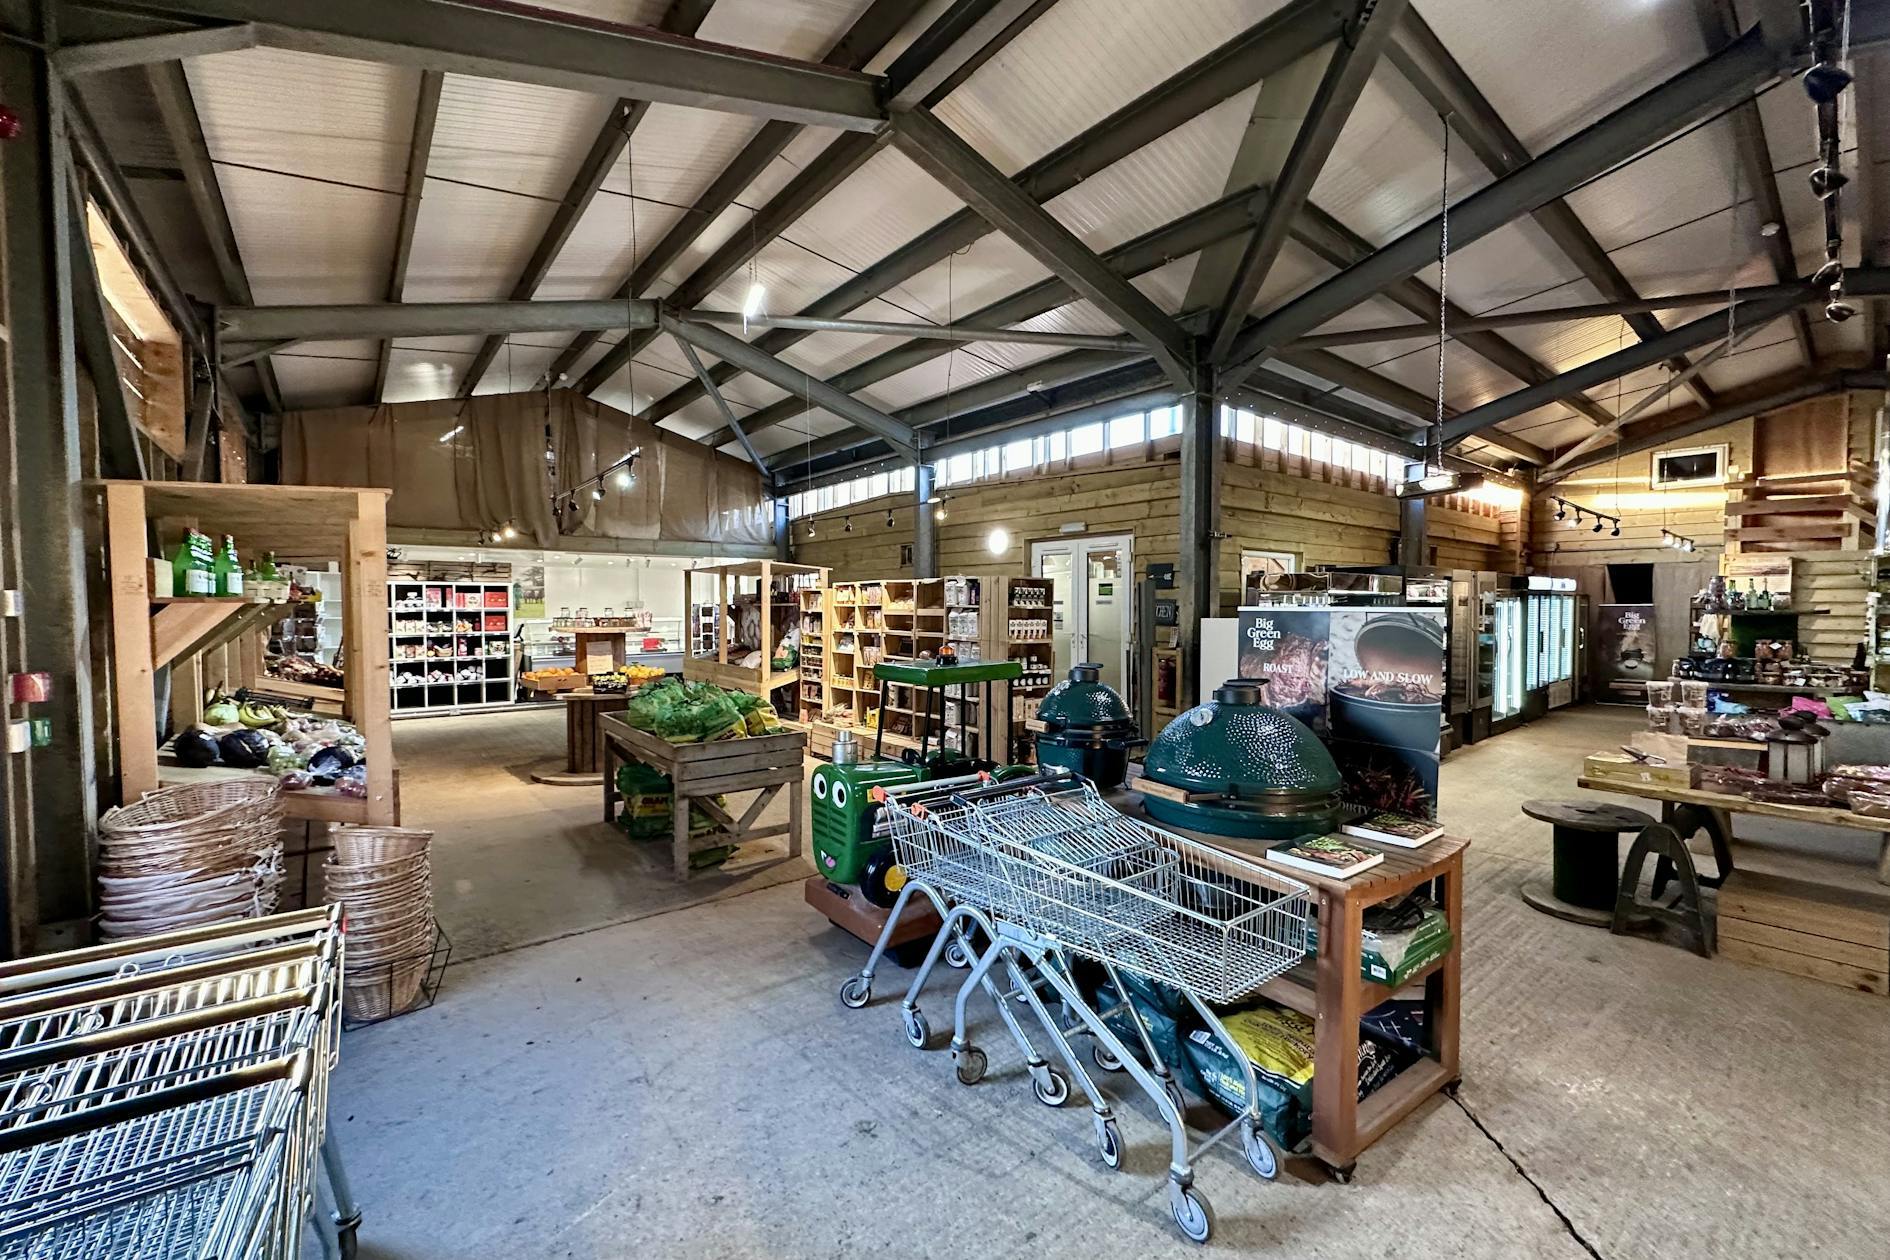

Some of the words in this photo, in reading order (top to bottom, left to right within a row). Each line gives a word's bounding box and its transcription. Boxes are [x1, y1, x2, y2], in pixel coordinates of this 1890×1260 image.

[1255, 618, 1274, 631] Big
[1247, 627, 1281, 639] Green
[1253, 639, 1274, 651] Egg
[1263, 663, 1293, 674] ROAST
[1343, 669, 1369, 680] LOW
[1370, 671, 1394, 682] AND
[1397, 672, 1433, 685] SLOW
